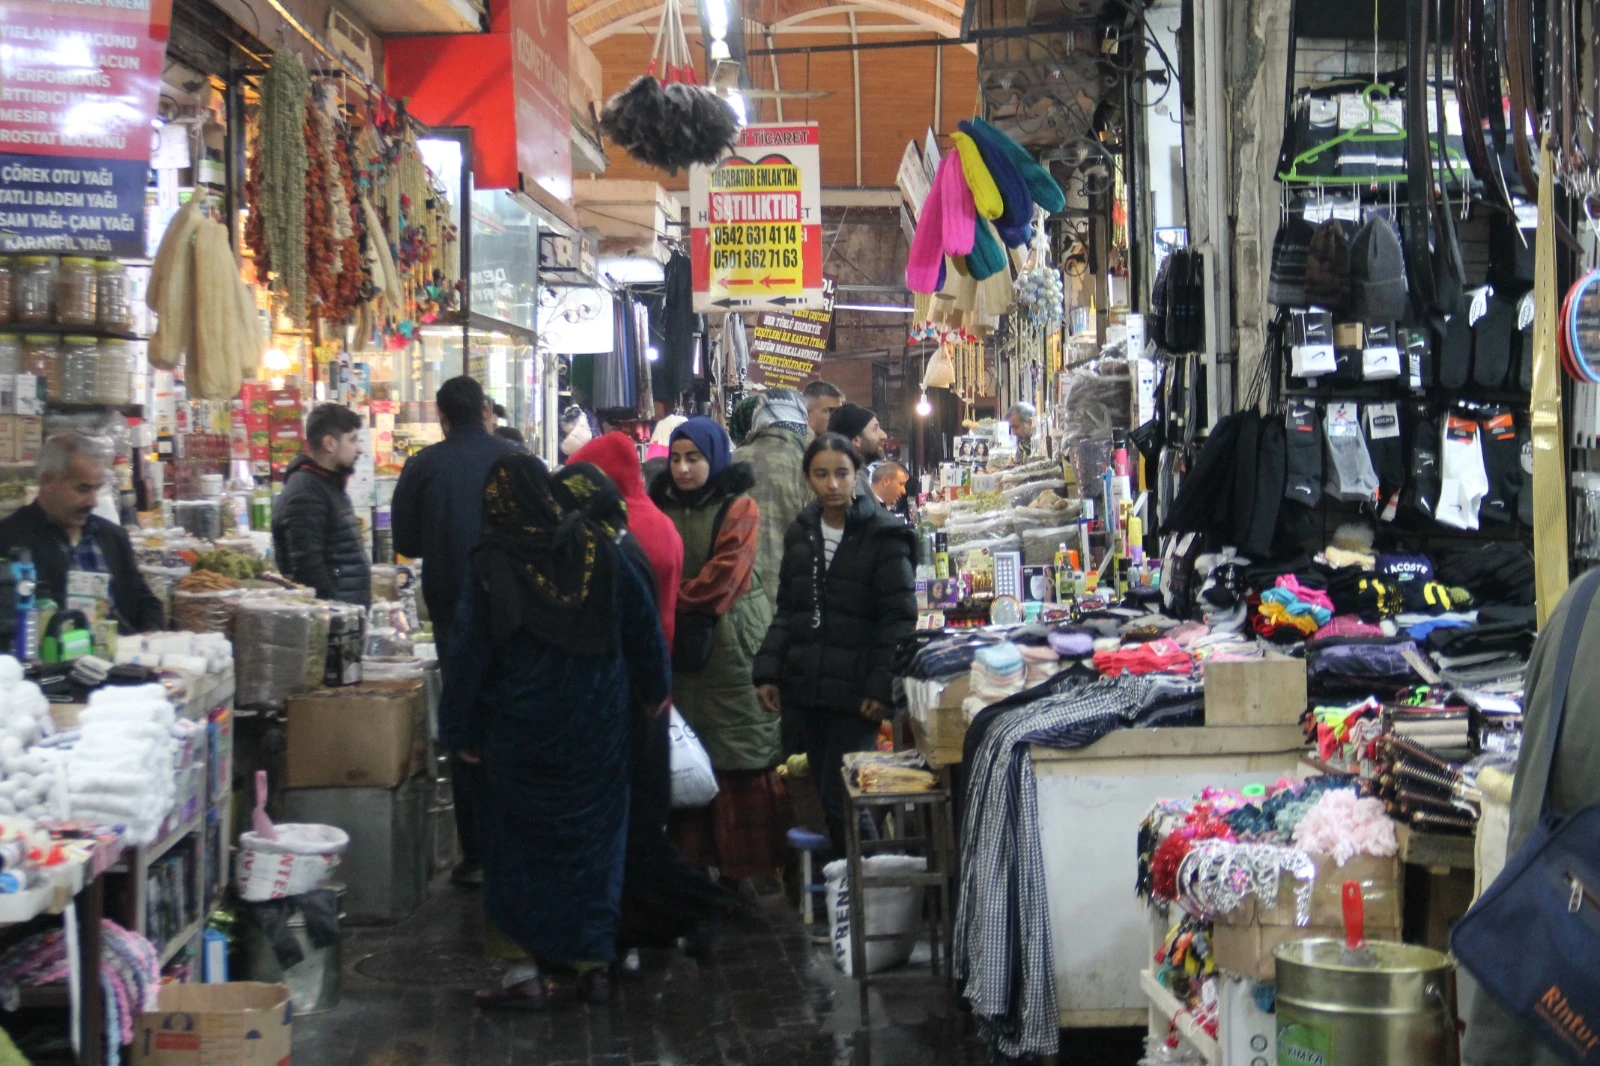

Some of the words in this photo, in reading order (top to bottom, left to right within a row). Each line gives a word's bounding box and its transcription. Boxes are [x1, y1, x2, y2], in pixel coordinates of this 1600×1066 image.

[753, 130, 809, 145] TİCARET
[2, 163, 50, 184] ÇÖREK
[52, 170, 80, 184] OTU
[82, 167, 113, 187] YAĞI
[756, 167, 798, 187] EMLAK'TAN
[0, 189, 33, 205] TATLI
[35, 191, 84, 207] BADEM
[86, 190, 118, 209] YAĞI
[712, 192, 798, 221] SATILIKTIR
[69, 214, 101, 232] ÇAM
[103, 213, 135, 231] YAĞI
[79, 235, 112, 251] YAĞI
[714, 225, 743, 246] 0542
[746, 226, 767, 245] 631
[769, 226, 781, 244] 41
[784, 225, 796, 244] 14
[713, 249, 742, 269] 0501
[744, 249, 766, 268] 362
[769, 249, 780, 268] 71
[783, 248, 797, 268] 63
